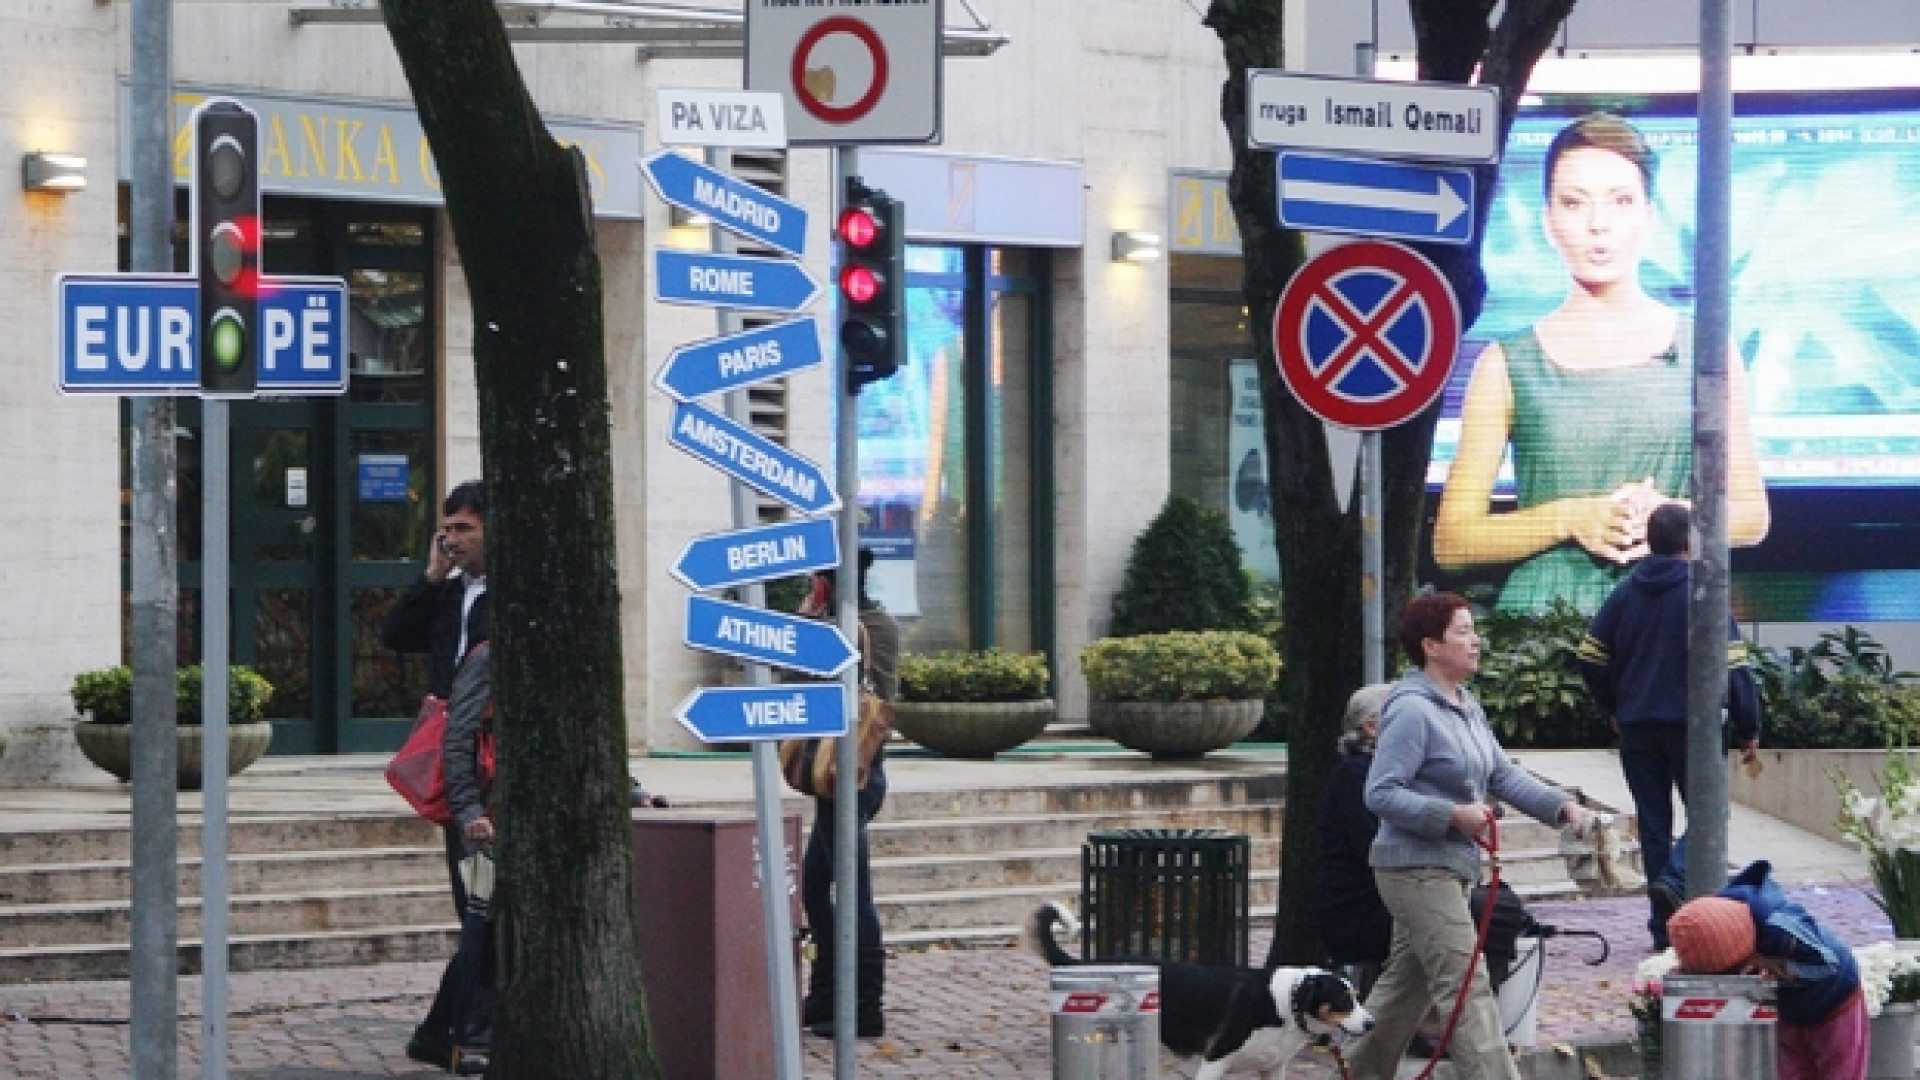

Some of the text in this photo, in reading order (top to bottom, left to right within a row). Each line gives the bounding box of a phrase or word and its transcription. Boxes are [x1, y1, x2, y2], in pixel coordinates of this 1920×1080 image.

[672, 101, 768, 131] PA VIZA
[1259, 97, 1481, 134] rruga Ismail Qemali
[259, 113, 402, 184] ANKA
[693, 176, 781, 232] MADRID
[689, 266, 754, 295] ROME
[74, 295, 332, 371] EURPË
[718, 340, 782, 377] PARIS
[678, 412, 817, 502] AMSTERDAM
[728, 535, 806, 571] BERLIN
